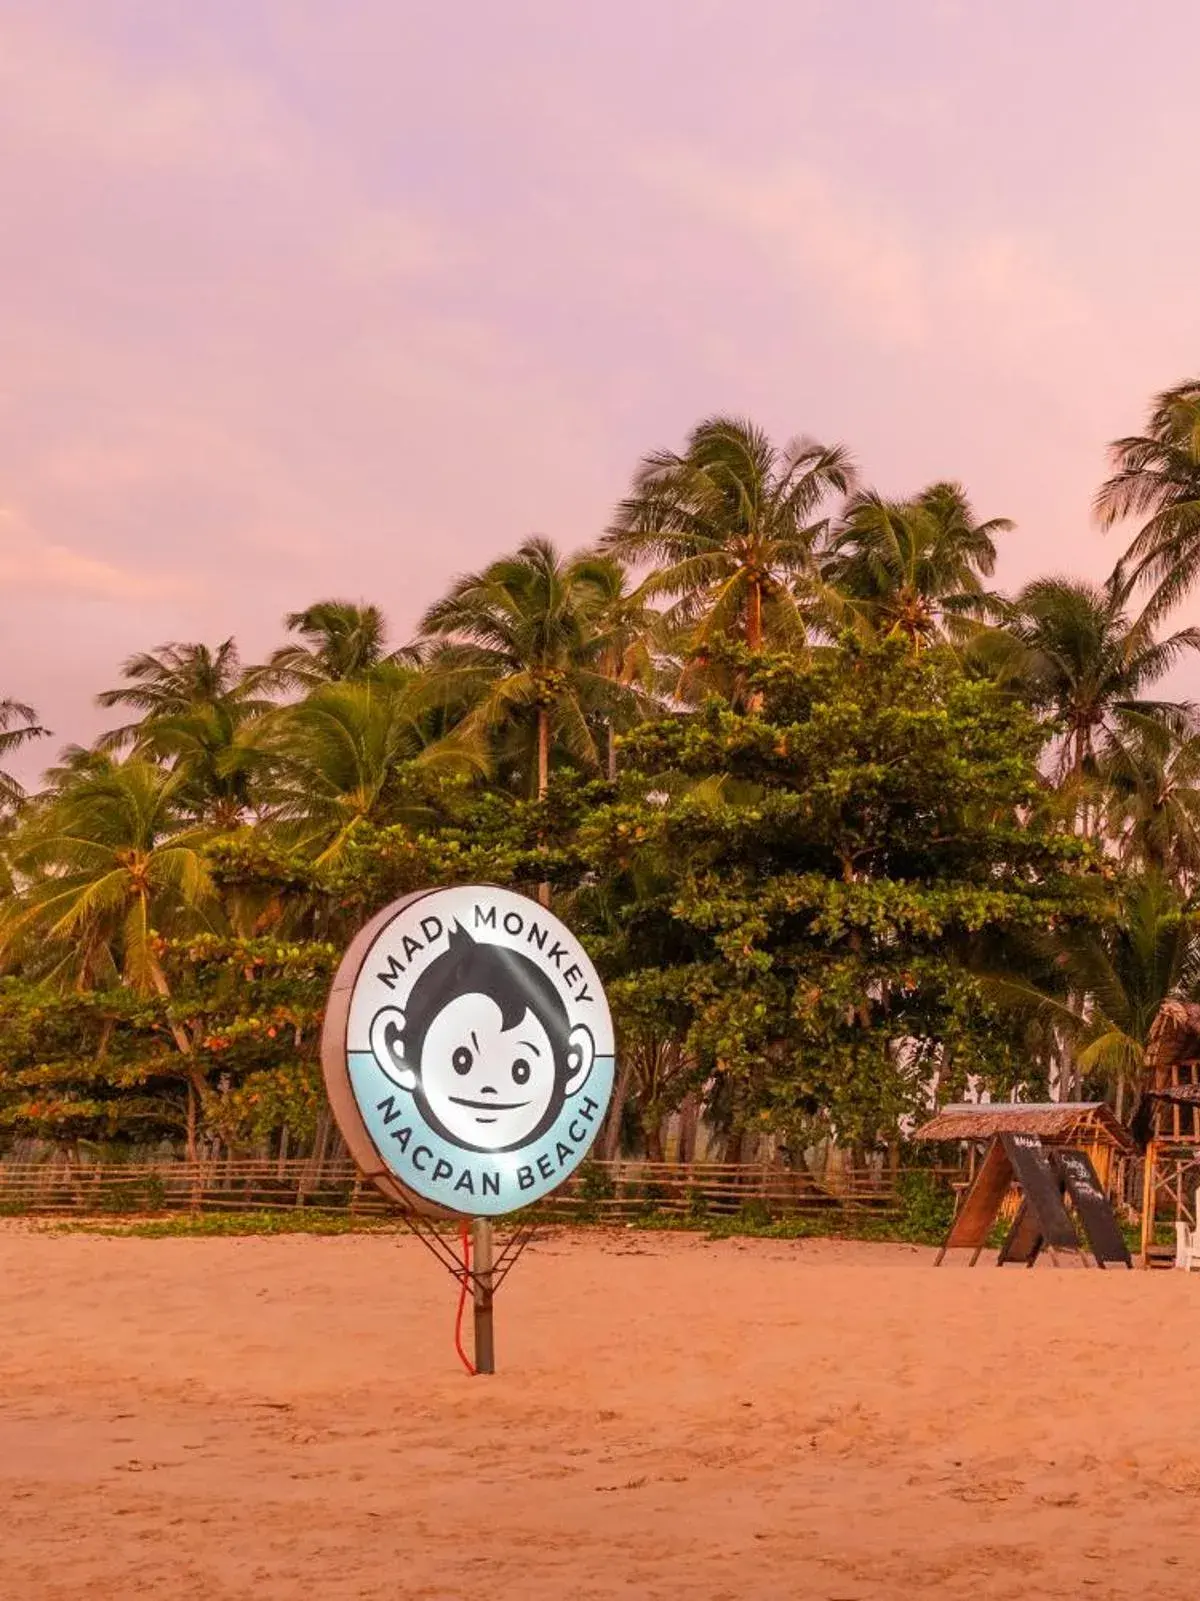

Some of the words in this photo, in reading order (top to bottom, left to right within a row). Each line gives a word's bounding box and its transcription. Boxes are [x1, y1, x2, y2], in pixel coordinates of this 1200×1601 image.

[377, 916, 443, 989] MAD
[474, 904, 594, 1004] MONKEY
[377, 1096, 500, 1195] NACPAN
[517, 1096, 599, 1190] BEACH
